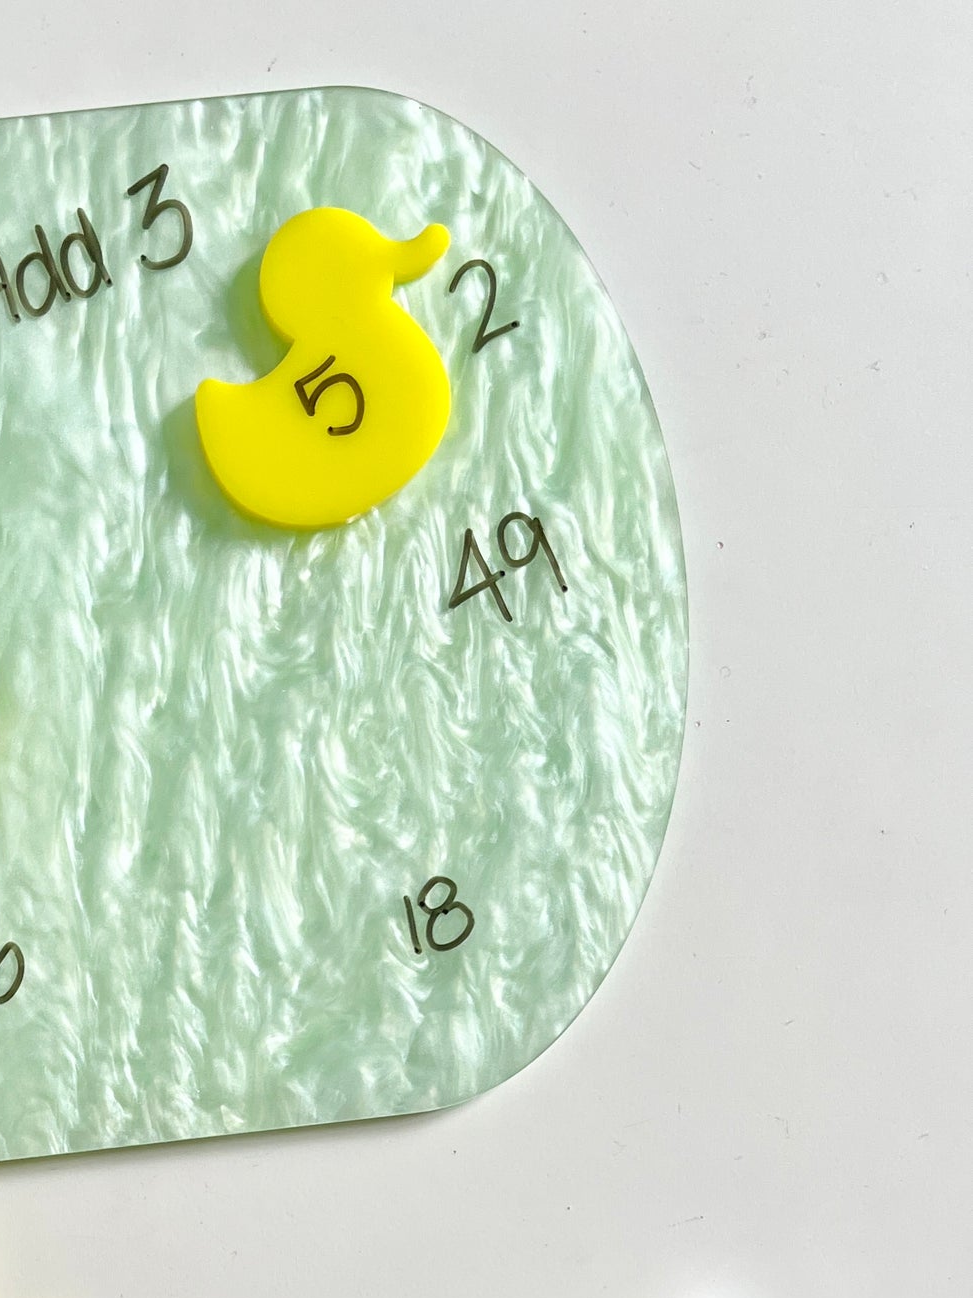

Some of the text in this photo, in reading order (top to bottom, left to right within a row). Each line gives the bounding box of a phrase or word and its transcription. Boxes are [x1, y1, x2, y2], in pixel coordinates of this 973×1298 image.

[128, 164, 194, 270] 3
[448, 259, 519, 353] 2
[294, 355, 365, 437] 5
[449, 512, 568, 623] 49
[403, 875, 476, 954] 18
